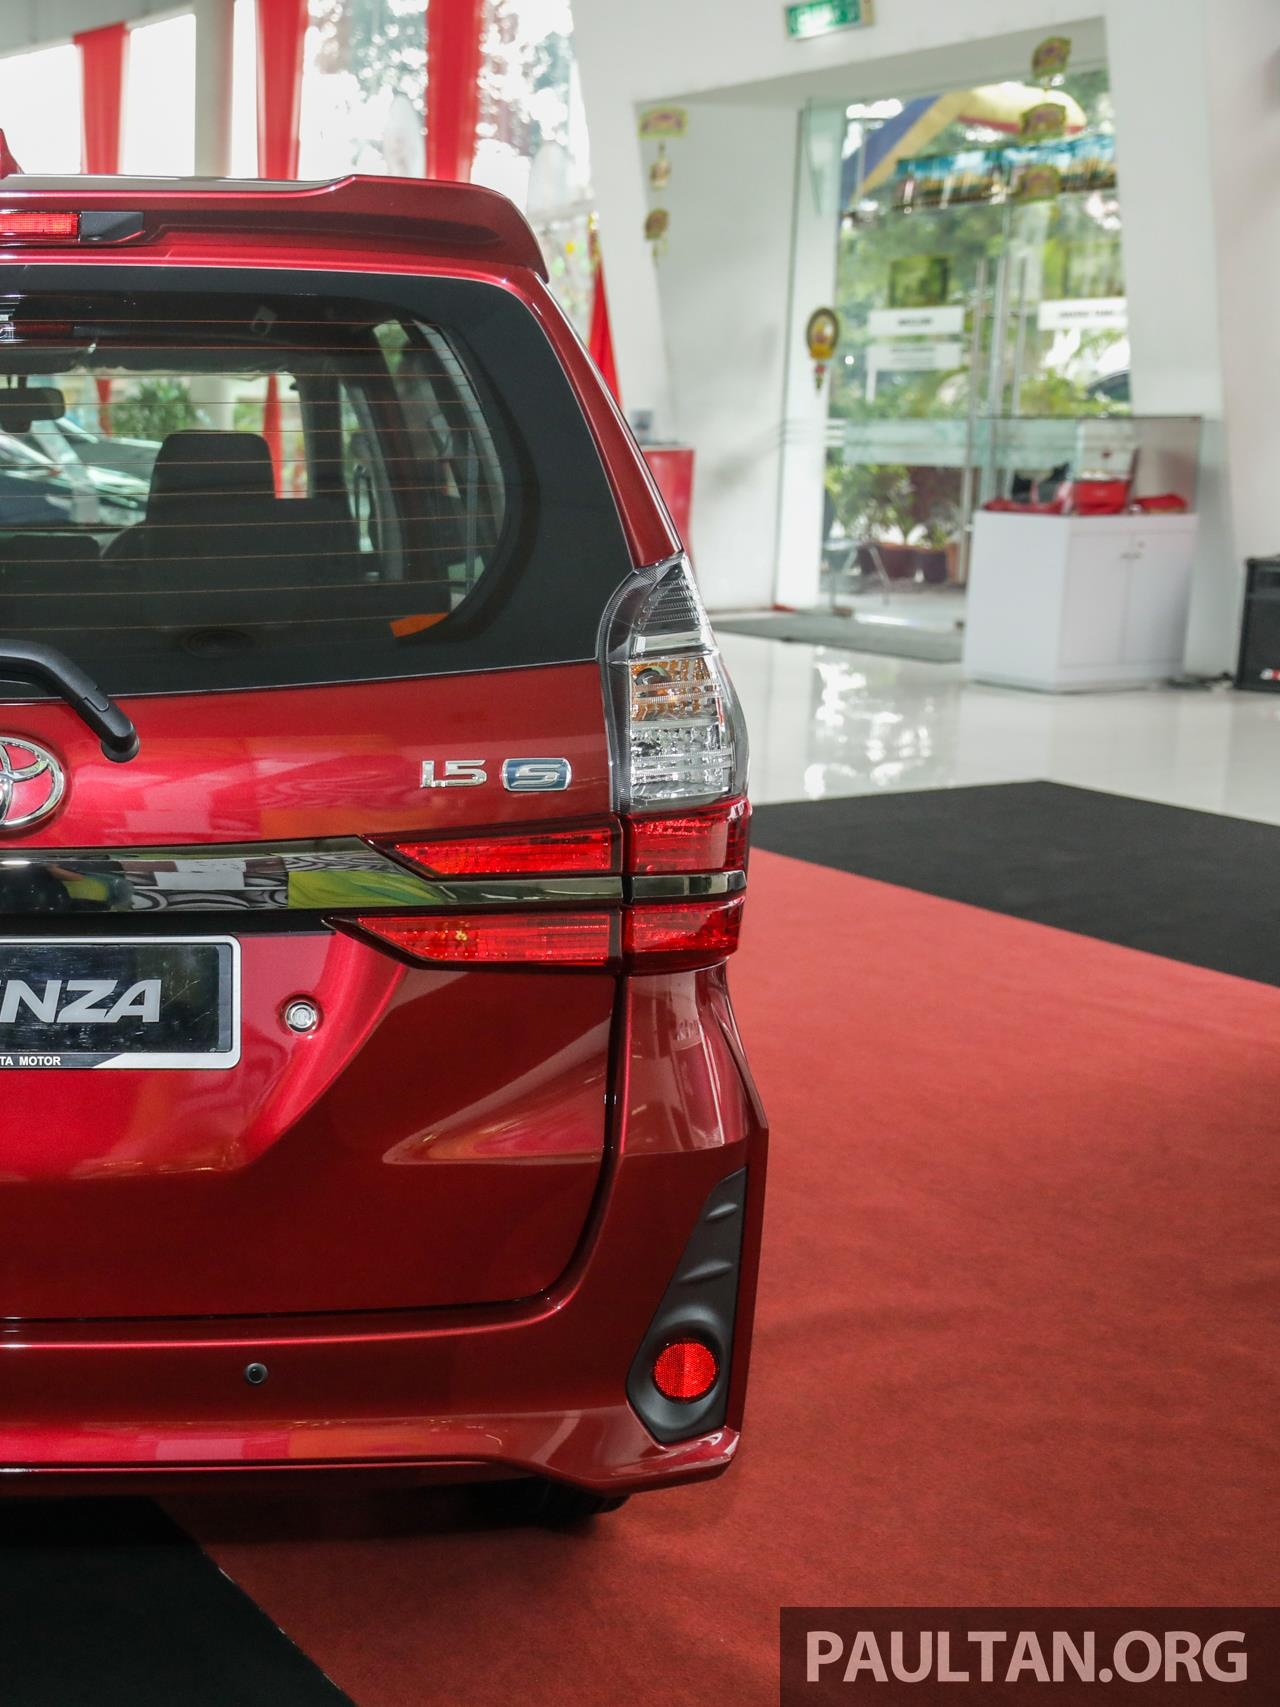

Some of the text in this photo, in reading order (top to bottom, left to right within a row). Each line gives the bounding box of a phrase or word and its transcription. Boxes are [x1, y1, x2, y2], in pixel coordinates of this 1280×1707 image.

[420, 759, 565, 789] 1.5 S
[19, 1055, 62, 1067] MOTOR
